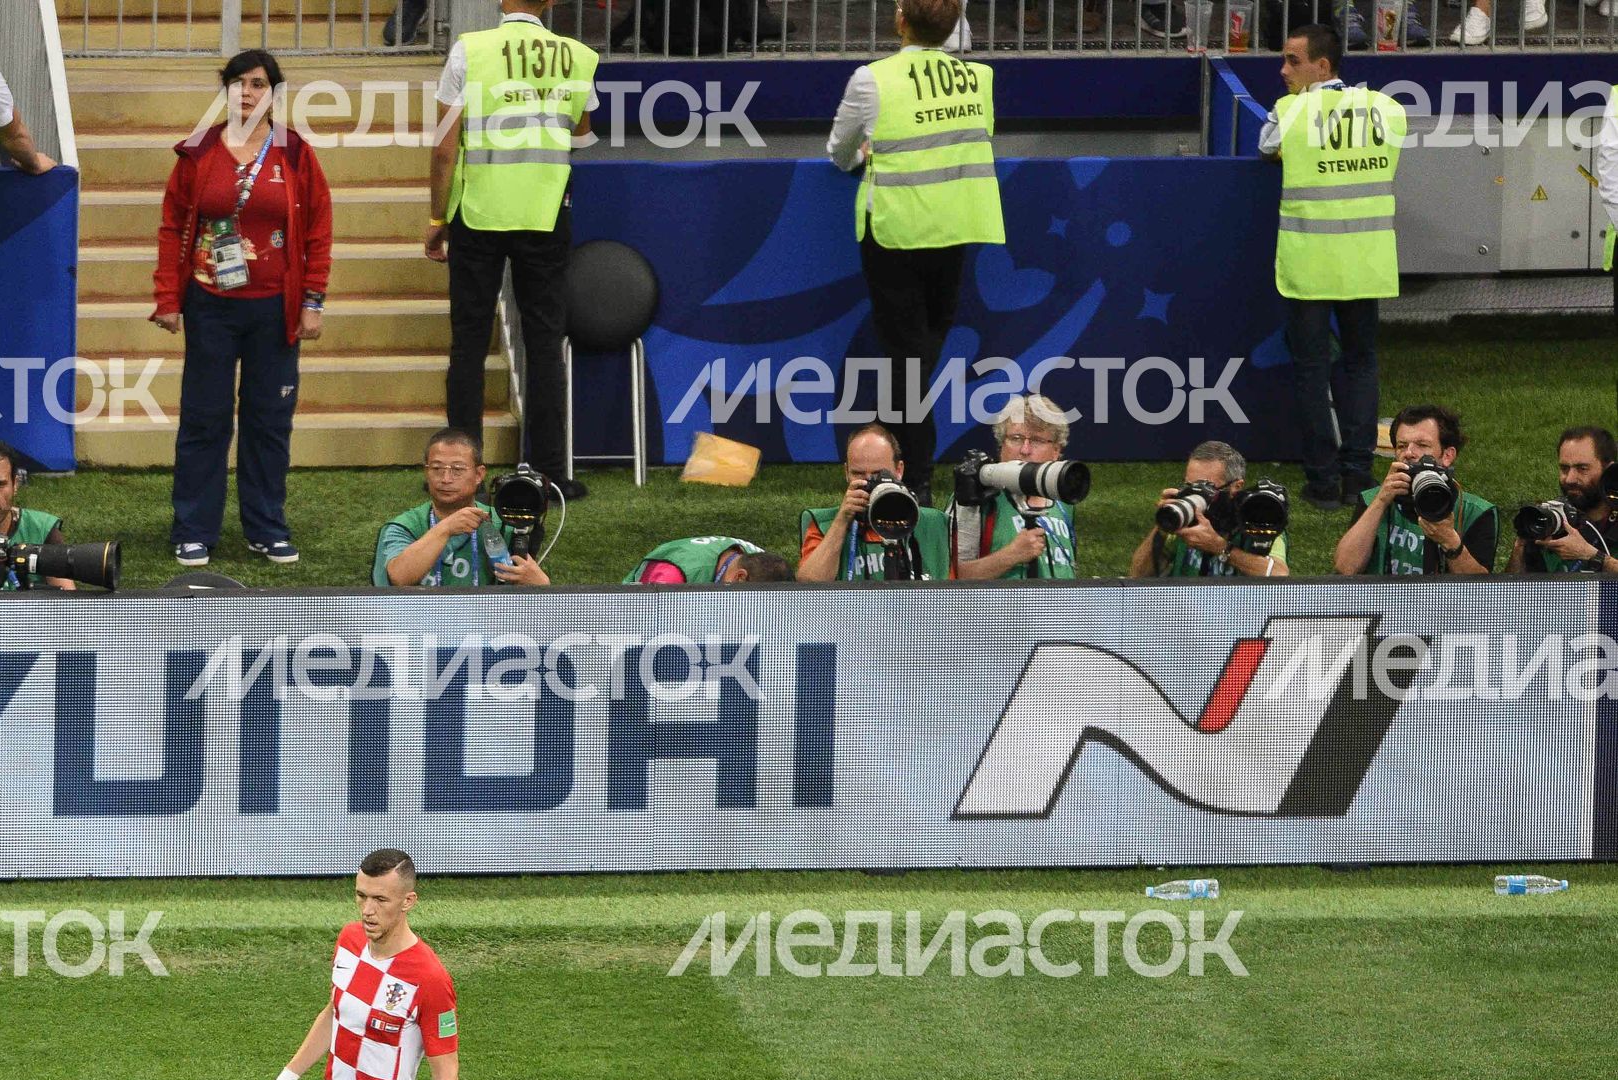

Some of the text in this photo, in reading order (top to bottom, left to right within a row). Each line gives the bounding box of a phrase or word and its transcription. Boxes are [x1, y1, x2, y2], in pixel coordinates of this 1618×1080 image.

[501, 38, 573, 79] 11370
[503, 87, 572, 103] STEWARD
[908, 59, 979, 100] 11055
[915, 103, 983, 124] STEWARD
[1314, 106, 1385, 150] 10778
[1317, 156, 1389, 174] STEWARD
